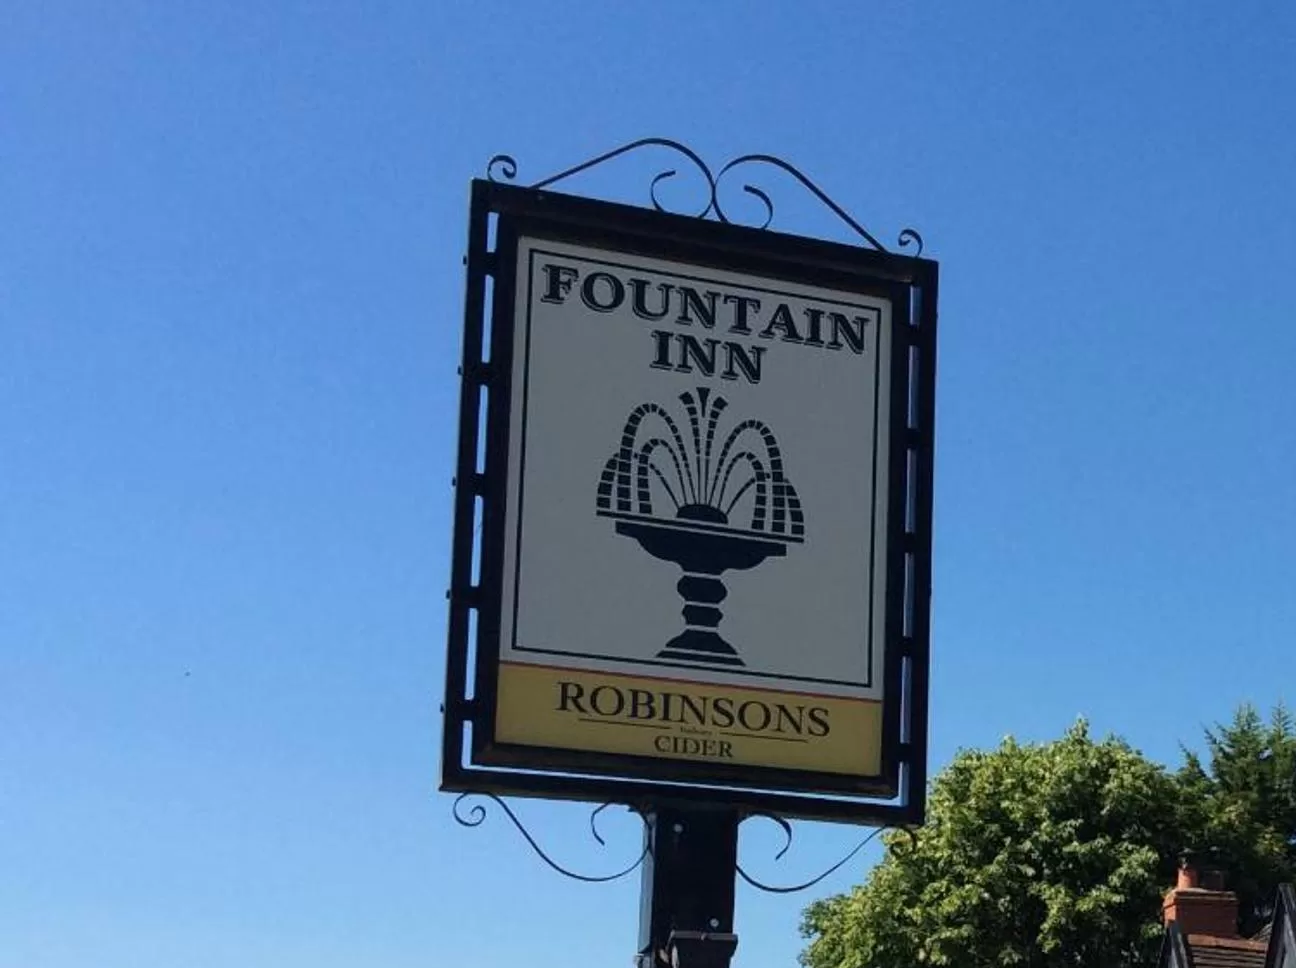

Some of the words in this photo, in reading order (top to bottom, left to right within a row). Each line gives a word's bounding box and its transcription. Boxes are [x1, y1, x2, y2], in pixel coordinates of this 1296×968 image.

[541, 264, 871, 354] FOUNTAIN
[650, 331, 767, 384] INN
[555, 681, 831, 737] ROBINSONS
[654, 735, 734, 758] CIDER
